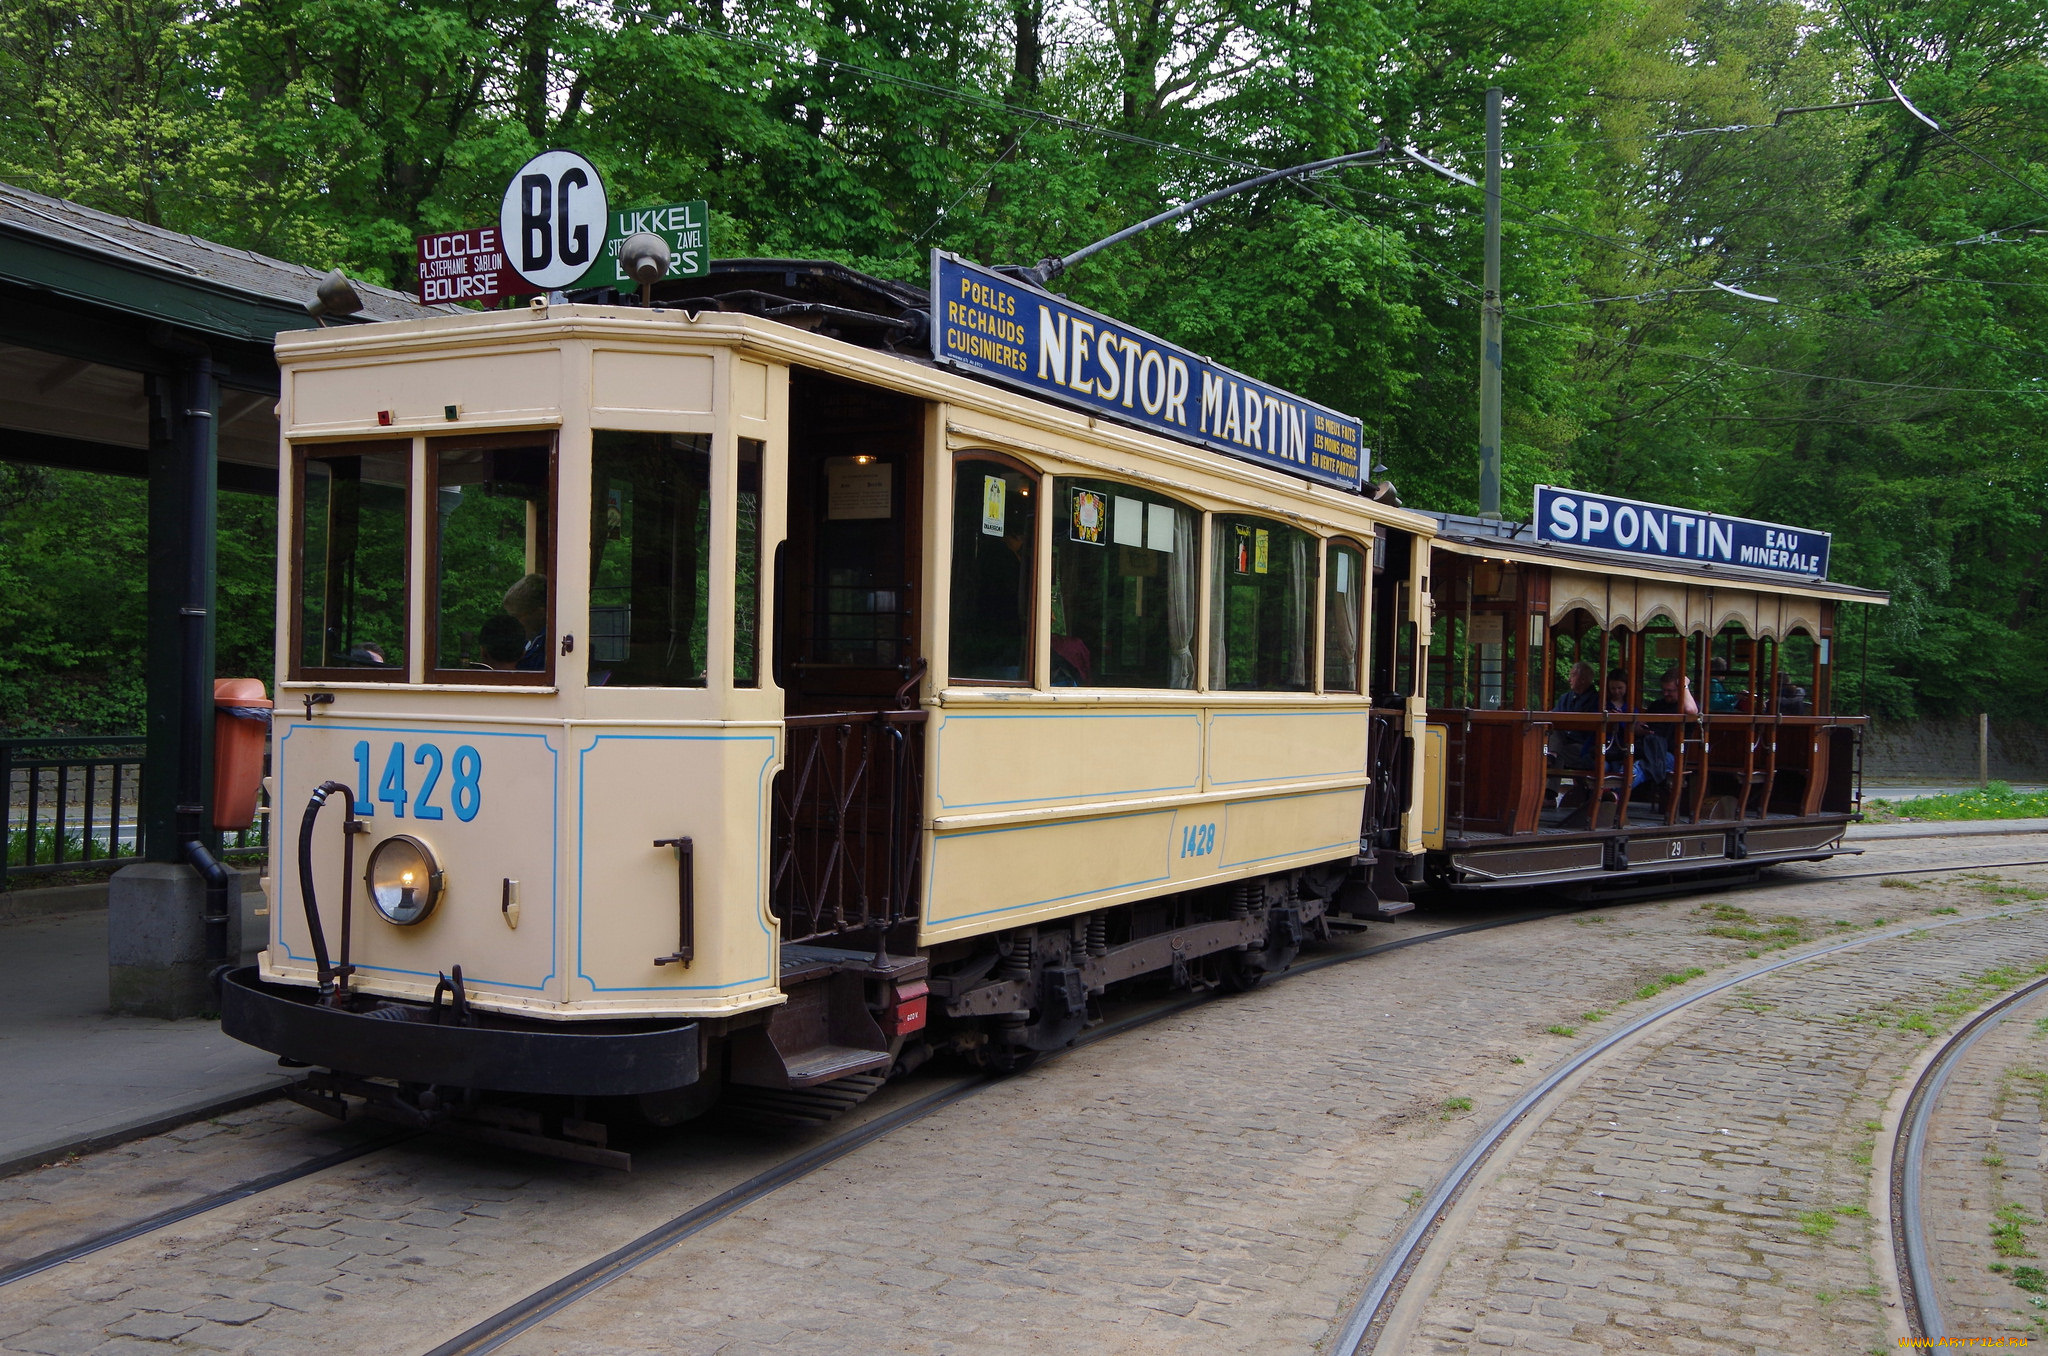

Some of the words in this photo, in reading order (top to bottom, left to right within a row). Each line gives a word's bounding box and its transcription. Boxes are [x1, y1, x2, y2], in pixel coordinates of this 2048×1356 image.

[521, 167, 590, 272] BG
[620, 206, 702, 236] UKKEL
[423, 229, 495, 260] UCCLE
[677, 230, 704, 250] ZAVEL
[473, 252, 503, 272] SABLON
[424, 272, 498, 301] BOURSE
[961, 277, 1016, 317] POELES
[948, 300, 1025, 346] RECHAUDS
[947, 327, 1028, 373] CUISINIERES
[1037, 304, 1190, 427] NESTOR
[1199, 370, 1307, 465] MARTIN
[1314, 414, 1325, 432] LES
[1325, 418, 1341, 438] MIEUX
[1341, 424, 1356, 443] FAITS
[1313, 432, 1324, 450] LES
[1324, 436, 1340, 455] MOINS
[1341, 442, 1357, 461] CHERS
[1311, 451, 1320, 468] EN
[1320, 454, 1336, 473] VENTE
[1335, 460, 1359, 480] PARTOUT
[1549, 496, 1734, 561] SPONTIN
[1765, 529, 1798, 551] EAU
[1740, 544, 1820, 575] MINERALE
[353, 740, 482, 823] 1428
[1180, 822, 1216, 859] 1428
[1671, 841, 1682, 856] 29
